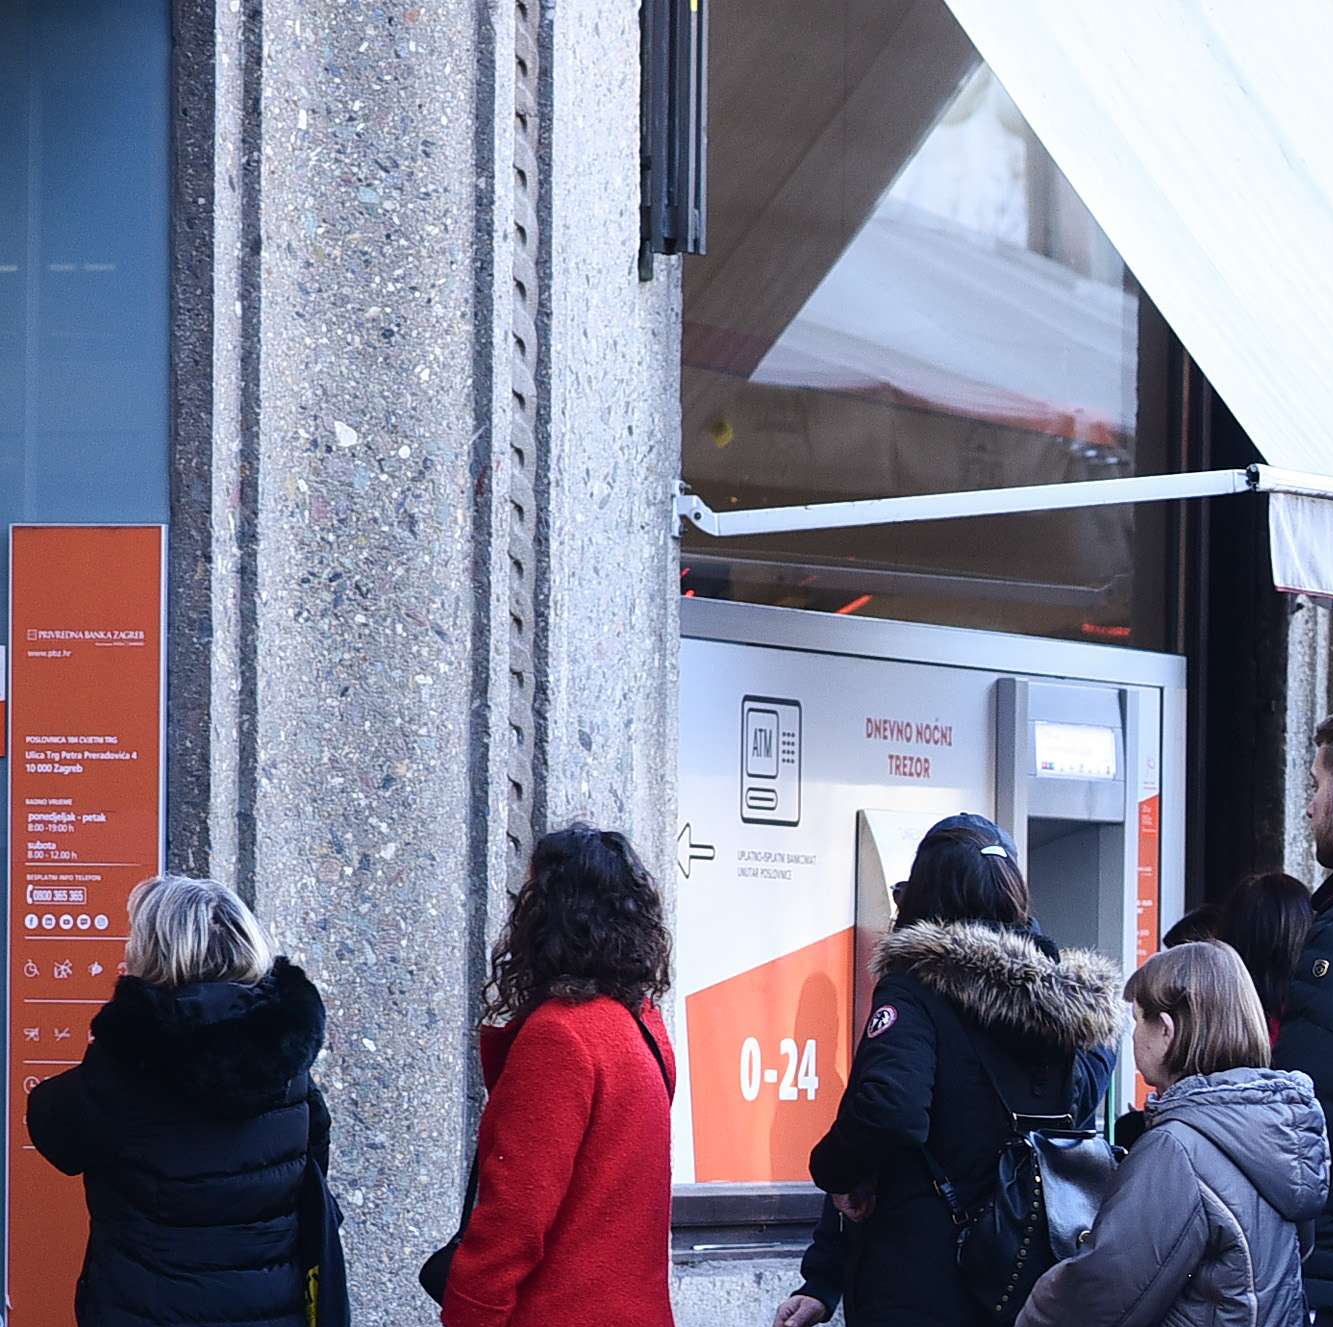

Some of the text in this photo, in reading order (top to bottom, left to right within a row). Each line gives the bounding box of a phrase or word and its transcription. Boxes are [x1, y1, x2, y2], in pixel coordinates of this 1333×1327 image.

[39, 631, 144, 639] PRIVREDNA BANKA ZAGREB
[866, 717, 952, 746] DNEVNO NOĆNI
[752, 728, 772, 758] ATM
[26, 751, 44, 759] Ulica
[46, 751, 59, 761] Trg
[61, 751, 82, 759] Petra
[26, 764, 83, 774] 10 000 Zagreb
[888, 754, 930, 778] TREZOR
[28, 812, 76, 822] ponedjeljak
[83, 813, 106, 823] petak
[28, 841, 56, 849] subota
[740, 1037, 819, 1101] 0-24
